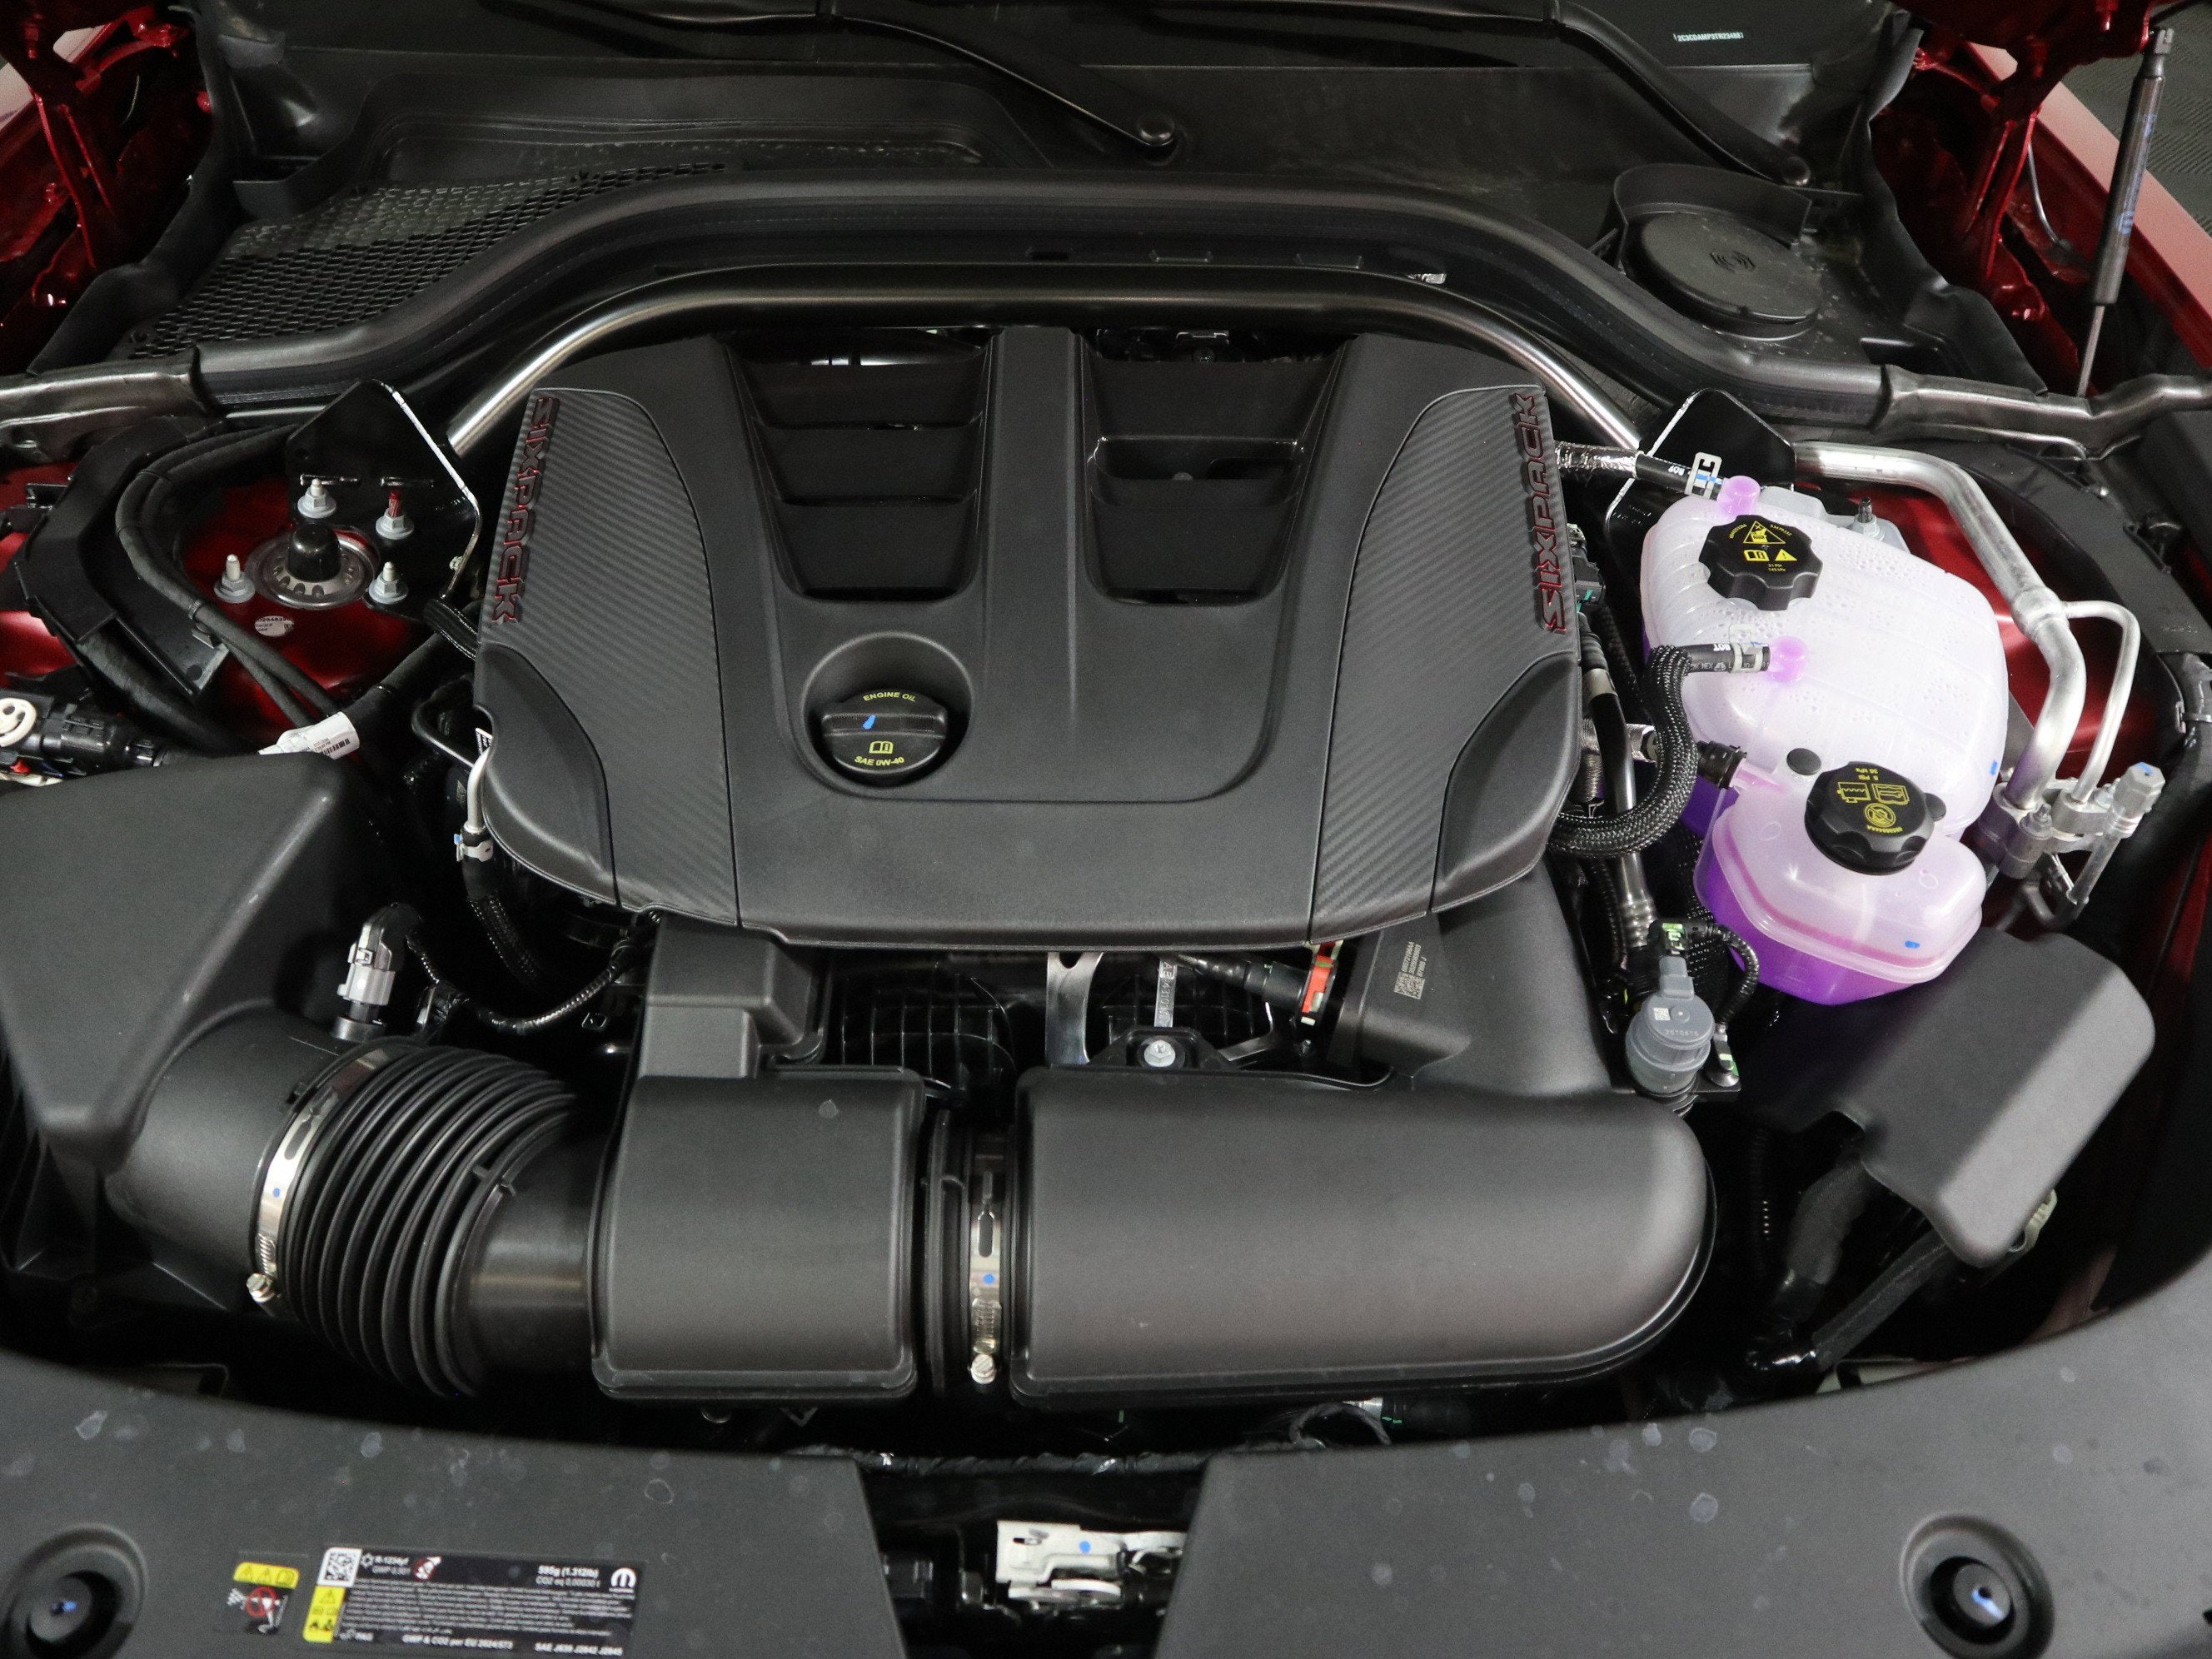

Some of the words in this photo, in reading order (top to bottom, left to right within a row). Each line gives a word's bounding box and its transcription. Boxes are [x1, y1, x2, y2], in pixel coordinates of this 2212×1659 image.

[863, 691, 900, 701] ENGINE
[902, 693, 916, 702] OIL
[854, 755, 875, 766] SAE
[875, 756, 904, 766] 0W-40
